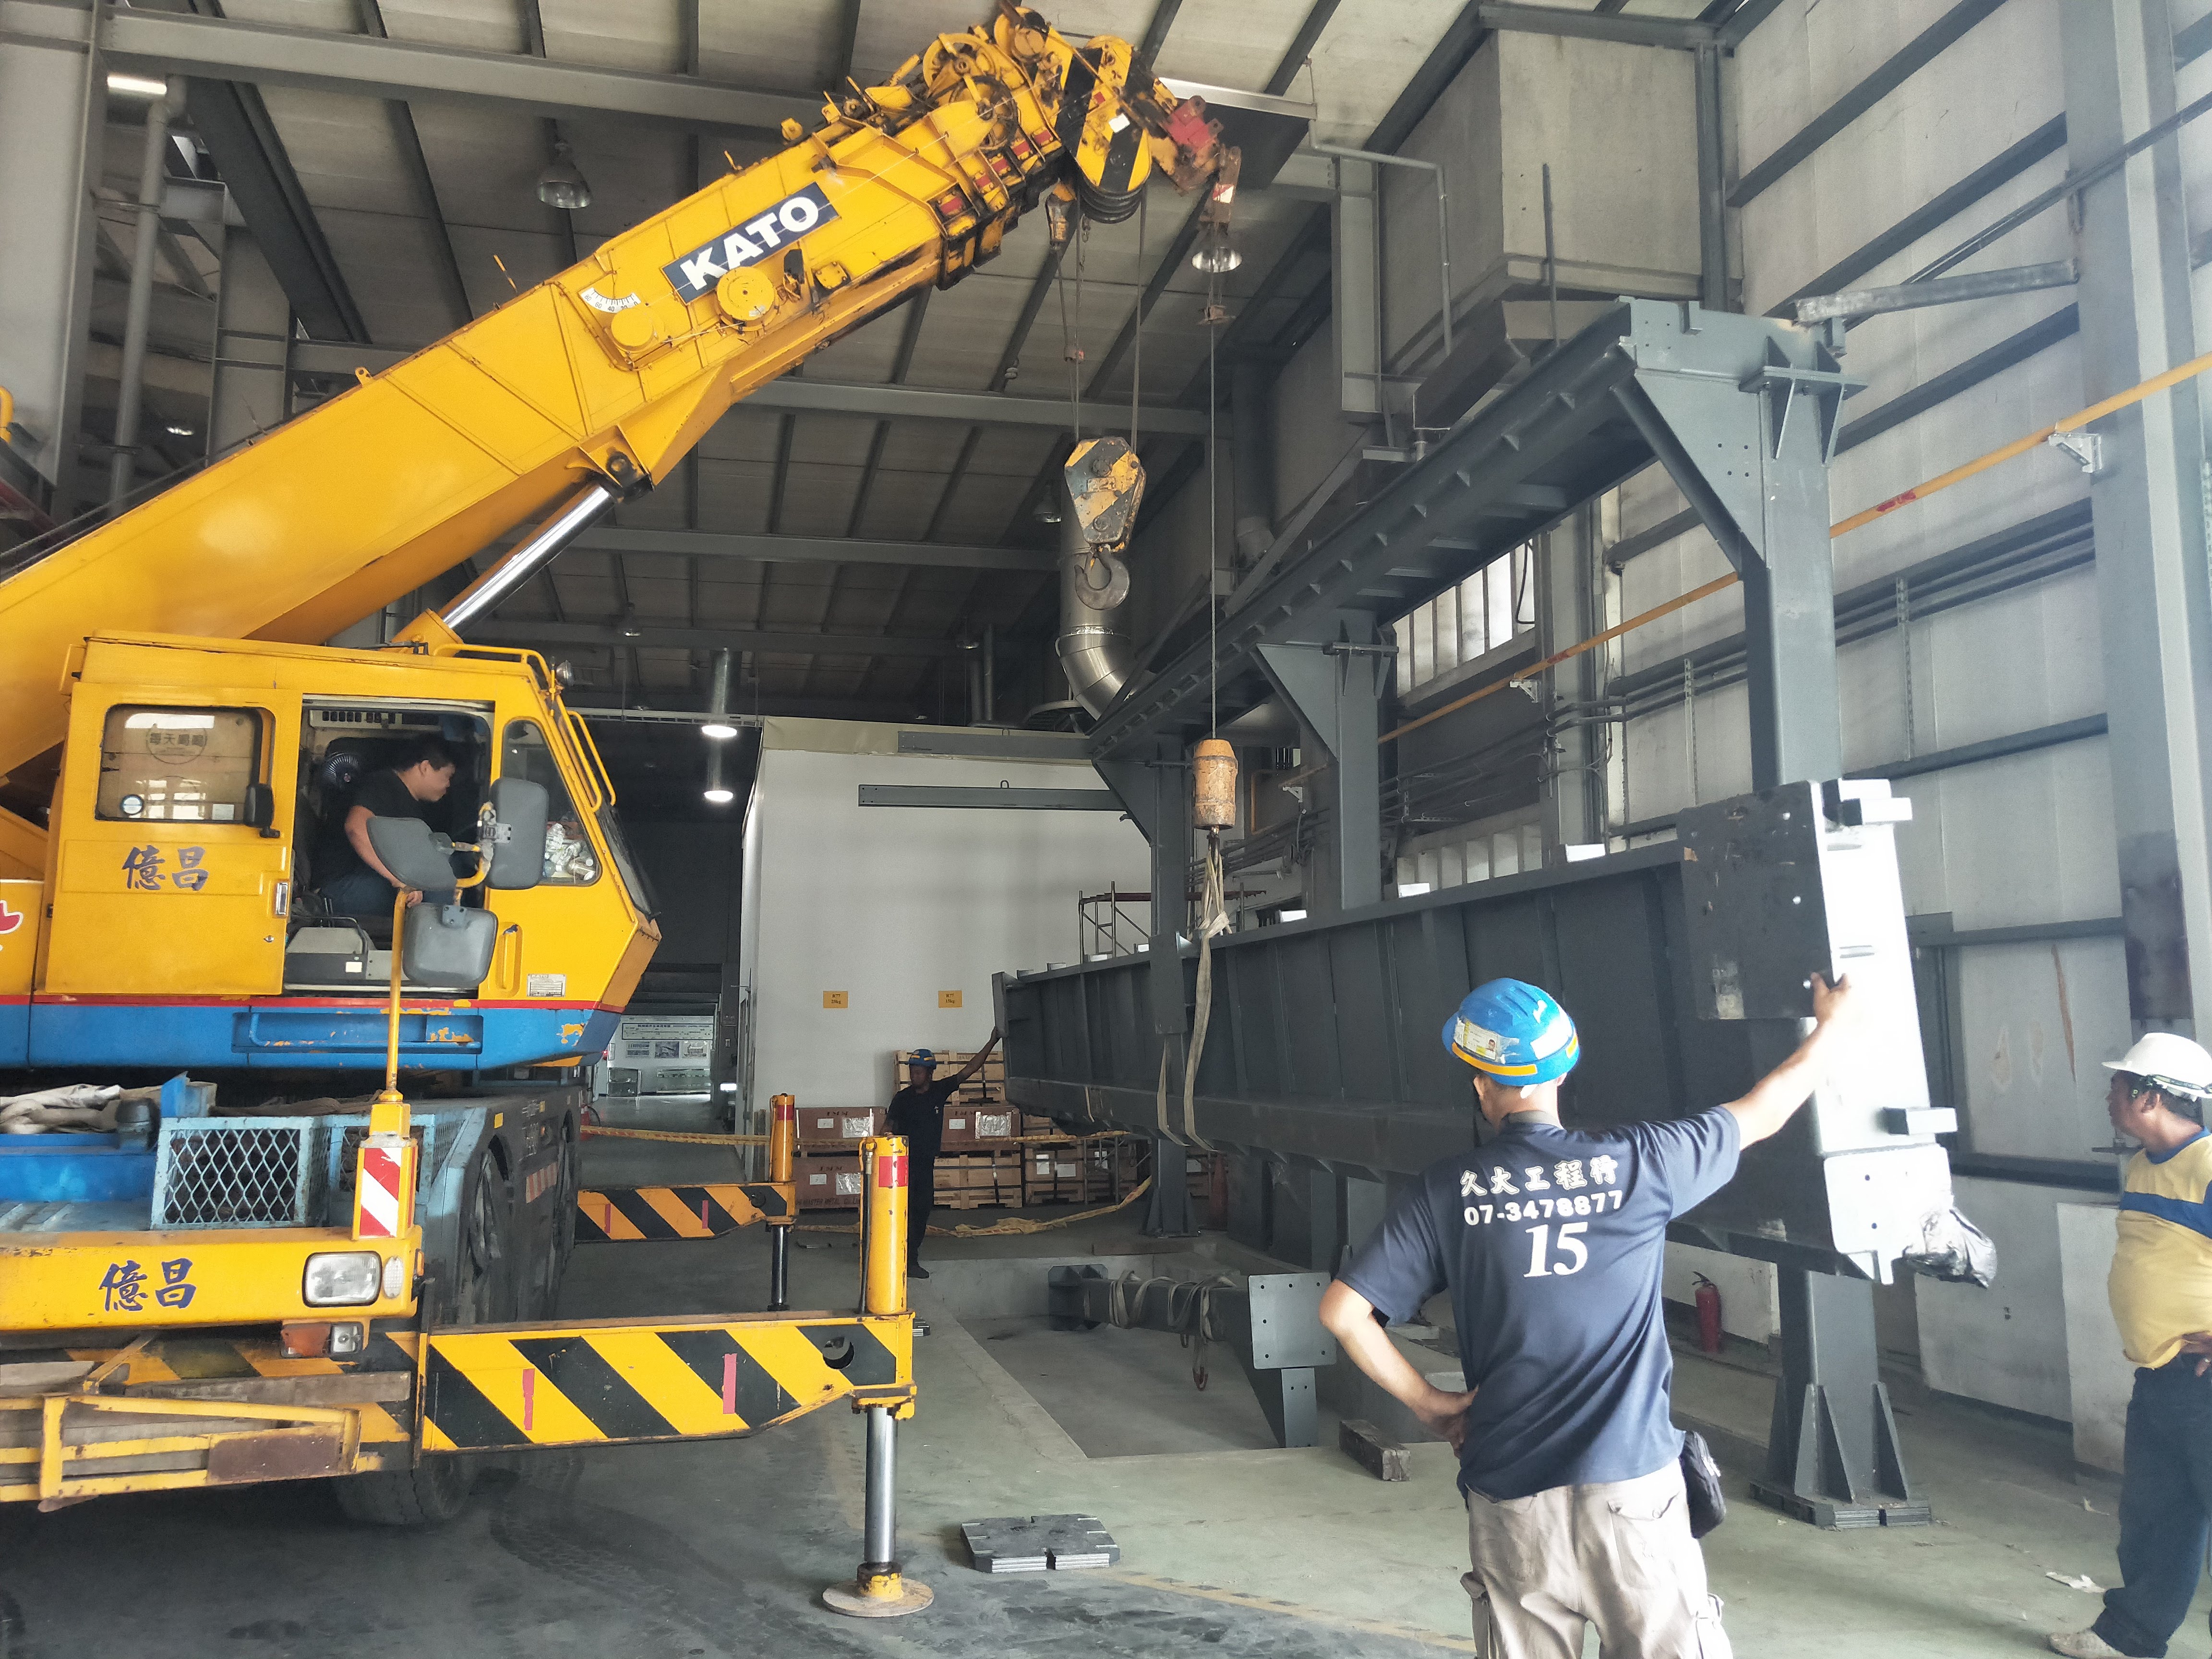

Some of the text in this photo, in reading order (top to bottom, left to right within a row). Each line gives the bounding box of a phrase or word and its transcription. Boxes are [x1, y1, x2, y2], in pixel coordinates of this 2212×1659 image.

[680, 197, 819, 291] KATO
[121, 845, 209, 891] 億昌
[1460, 1155, 1618, 1197] 久大工程行
[1464, 1190, 1623, 1226] 07-3478877
[1523, 1221, 1589, 1278] 15
[98, 1258, 197, 1311] 億昌
